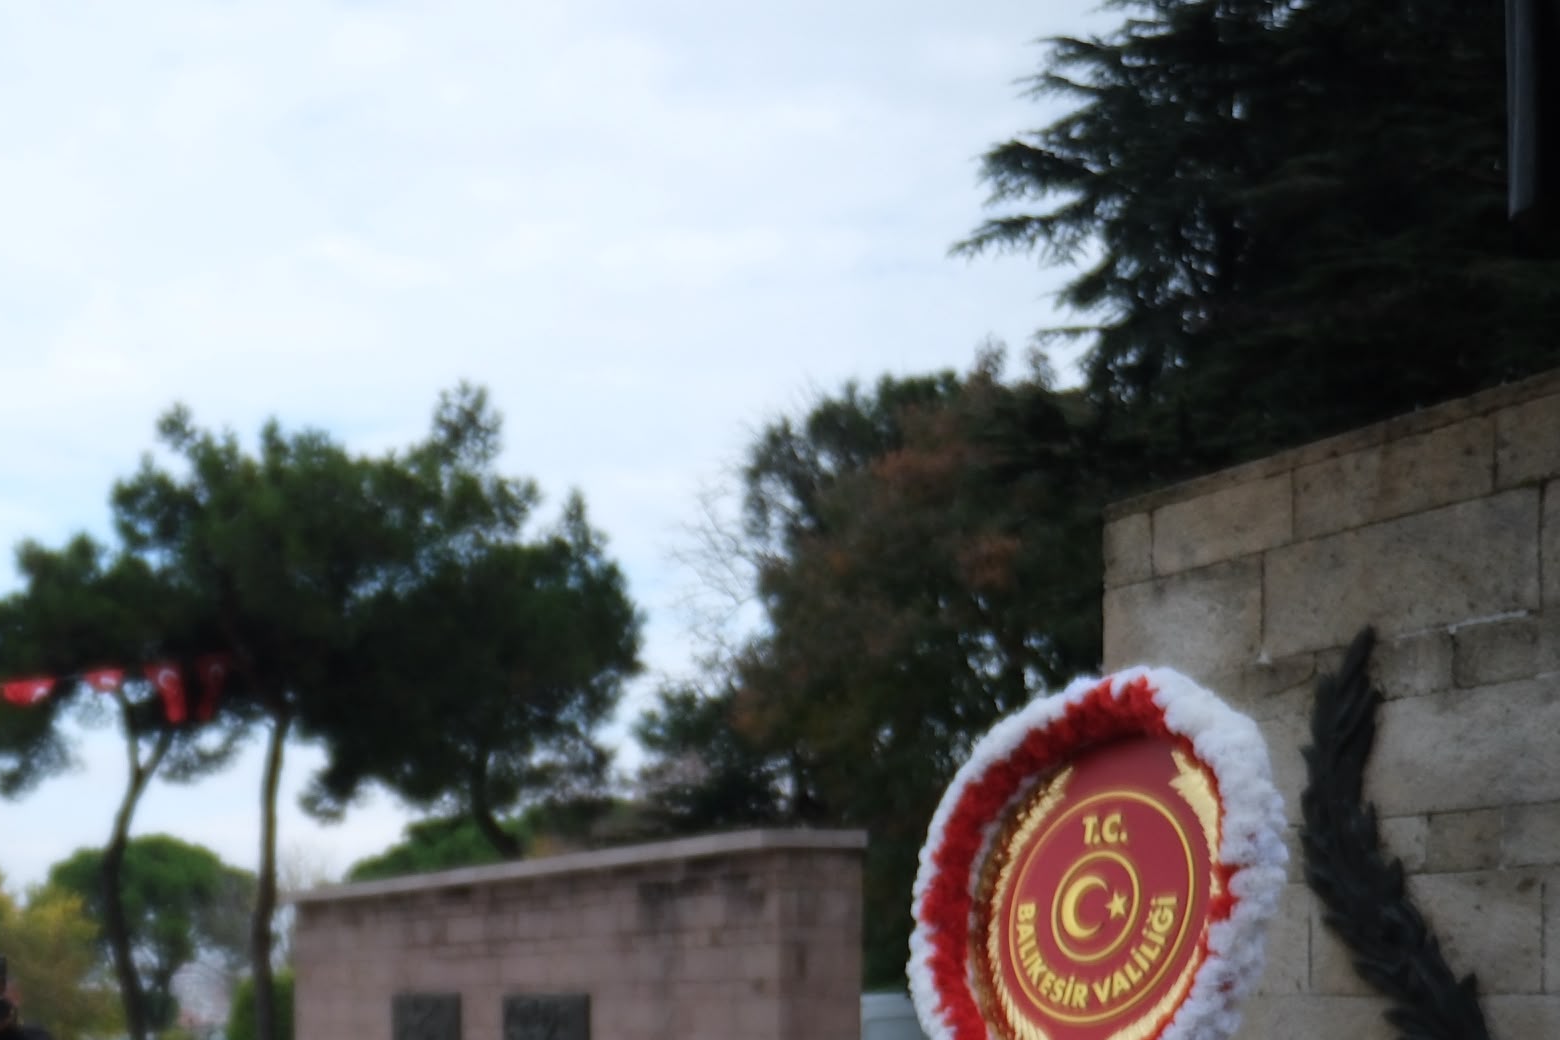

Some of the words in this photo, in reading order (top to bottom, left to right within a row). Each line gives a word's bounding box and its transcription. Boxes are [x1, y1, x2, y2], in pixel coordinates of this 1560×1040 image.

[1082, 813, 1128, 845] T.C.
[1017, 902, 1090, 1008] BALIKESİR
[1093, 895, 1178, 1003] VALİLİĞİ
